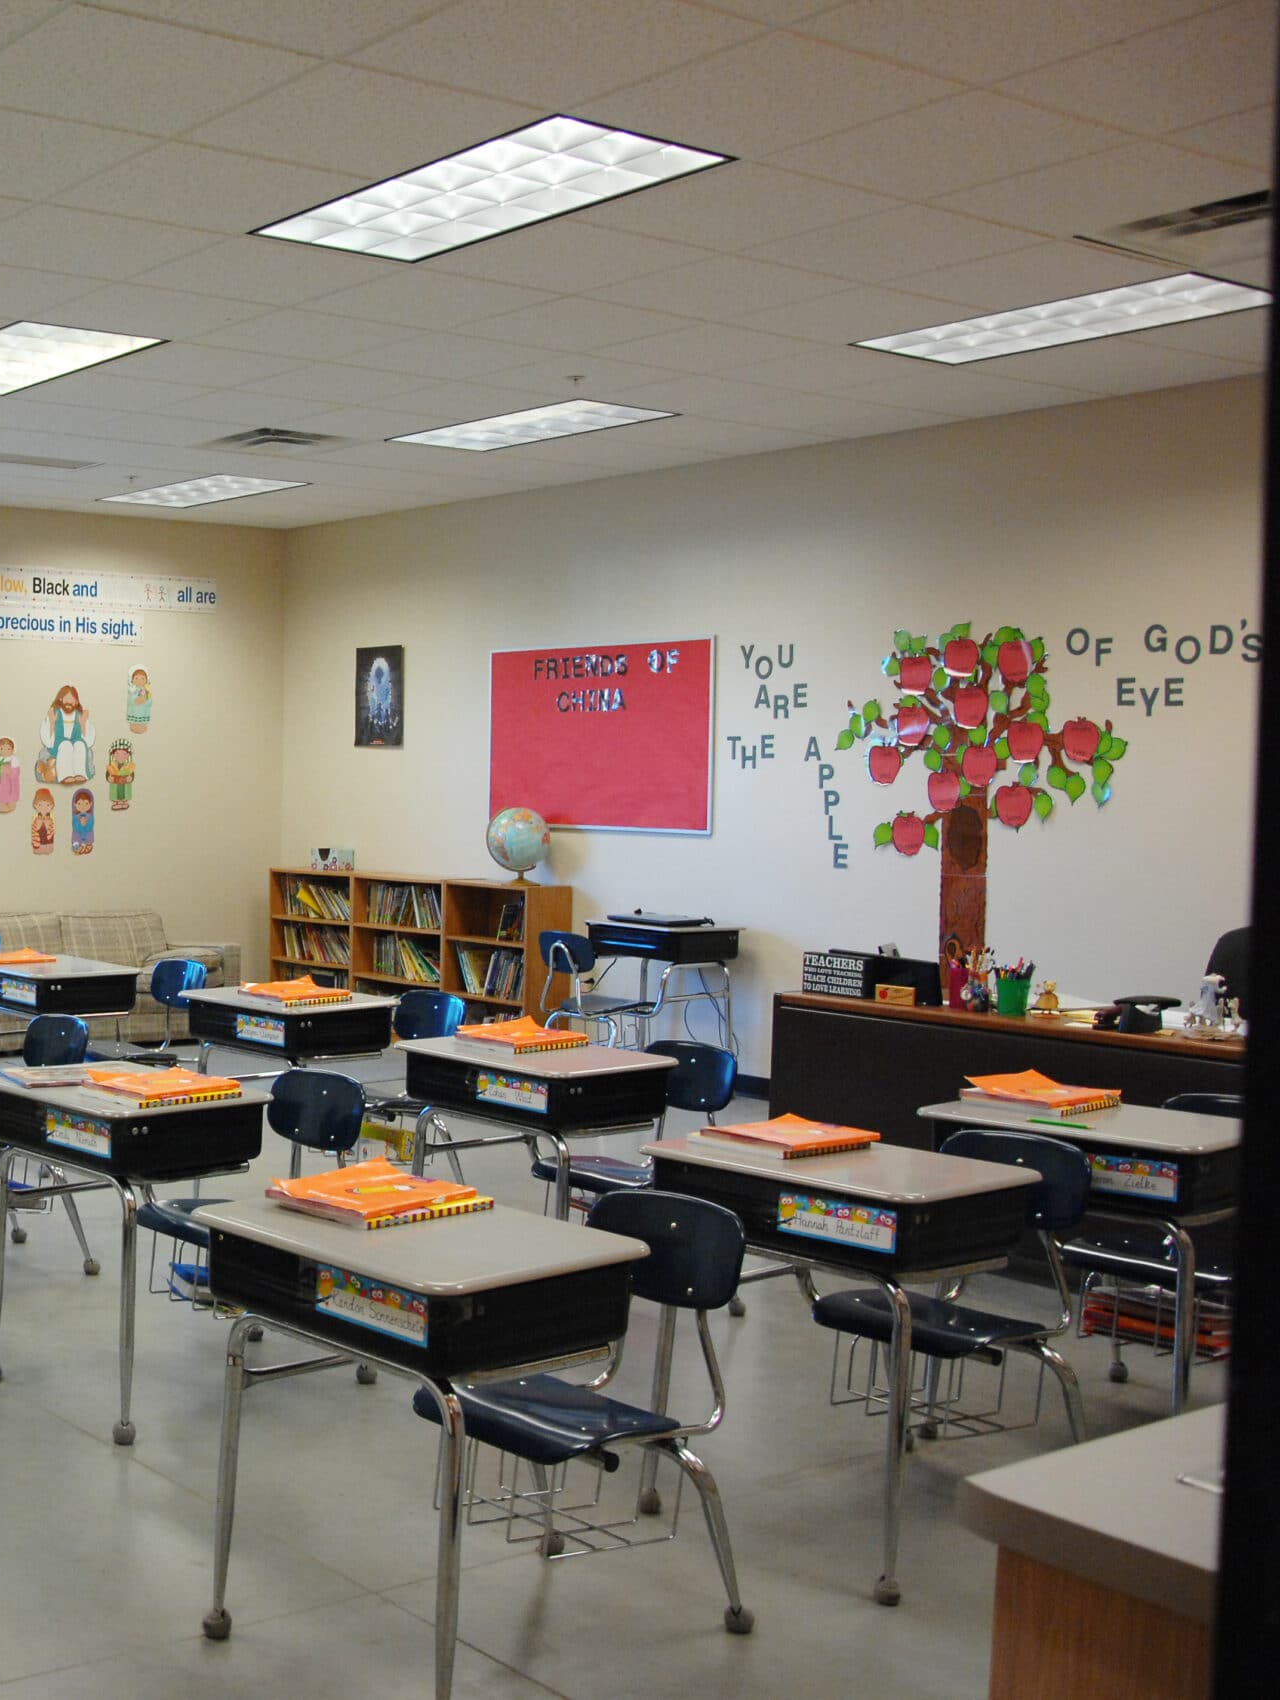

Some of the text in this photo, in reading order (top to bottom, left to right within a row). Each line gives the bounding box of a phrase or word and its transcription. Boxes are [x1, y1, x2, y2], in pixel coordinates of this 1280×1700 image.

[32, 577, 70, 597] Black
[72, 581, 99, 598] and
[177, 586, 192, 603] all
[195, 590, 217, 605] are
[58, 615, 72, 633] in
[75, 616, 98, 635] His
[101, 618, 138, 640] sight.
[739, 643, 795, 680] YOU
[1065, 626, 1114, 667] OF
[532, 648, 681, 681] FRIENDS OF
[556, 687, 627, 713] CHINA
[754, 682, 809, 720] ARE
[1116, 676, 1185, 718] EYE
[726, 733, 850, 870] THE APPLE
[805, 955, 864, 971] TEACHERS
[804, 973, 863, 988] TEACH CHILDREN
[812, 983, 829, 992] LOVE
